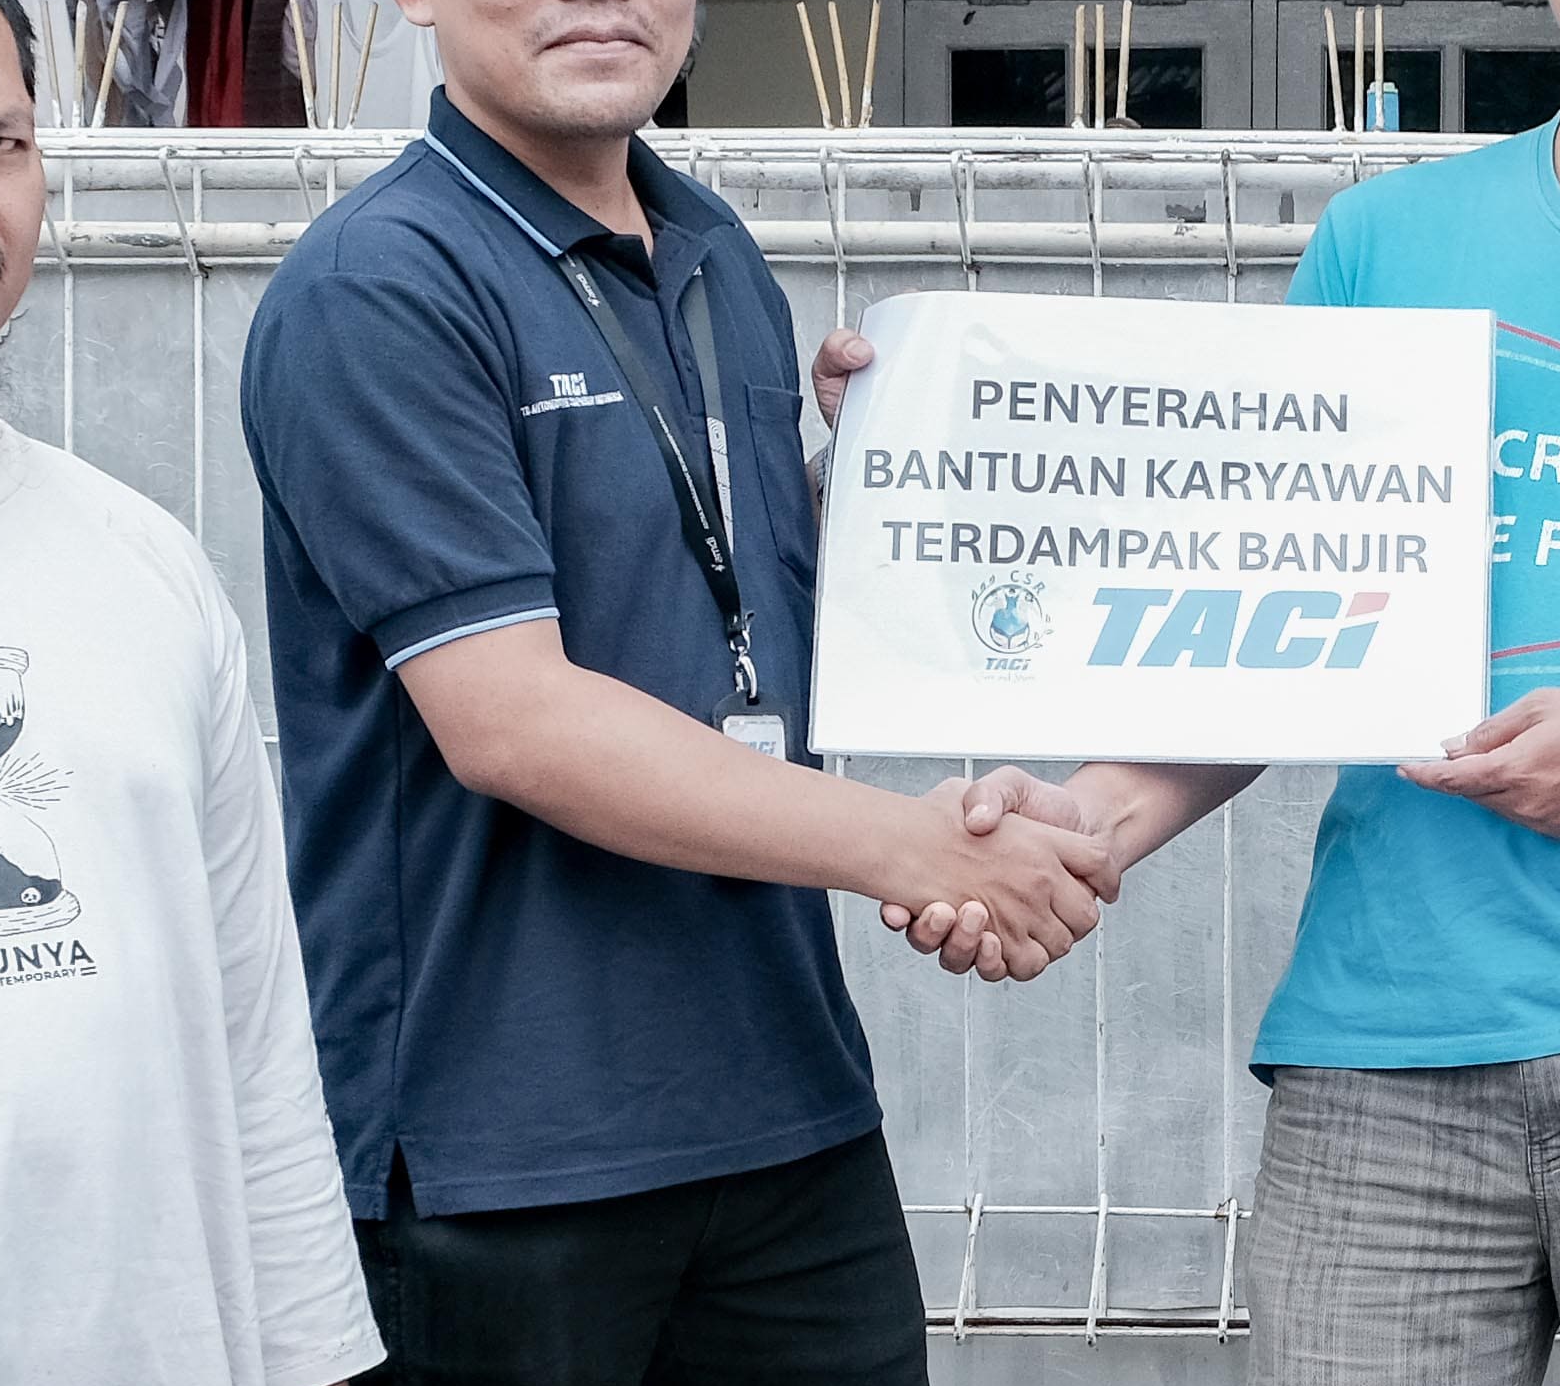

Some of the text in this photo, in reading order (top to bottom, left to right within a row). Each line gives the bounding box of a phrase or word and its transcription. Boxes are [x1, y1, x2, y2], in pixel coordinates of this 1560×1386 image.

[971, 379, 1349, 433] PENYERAHAN
[863, 449, 1453, 504] BANTUAN KARYAWAN
[882, 520, 1428, 574] TERDAMPAK BANJIR
[1010, 570, 1046, 595] CSR
